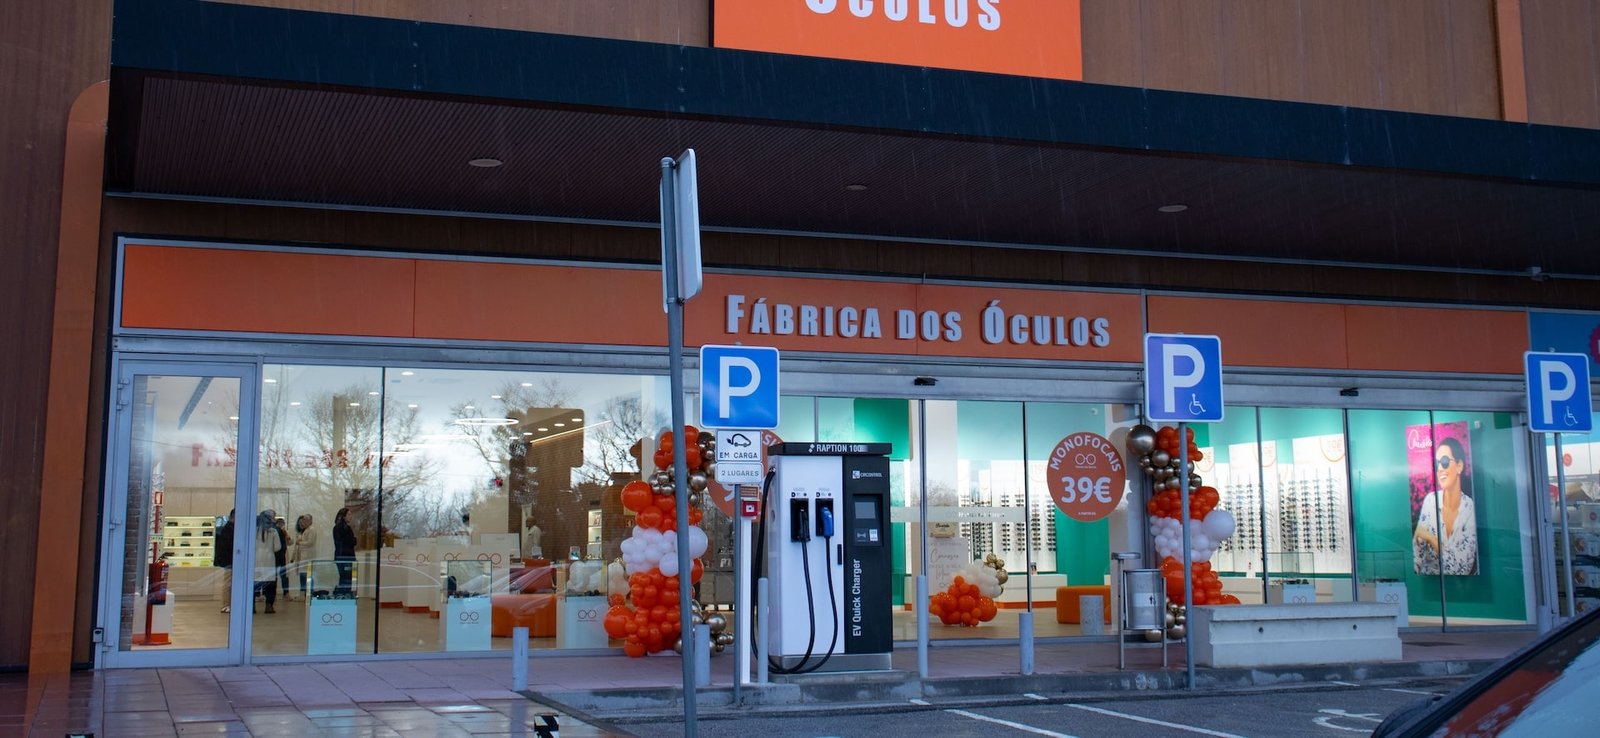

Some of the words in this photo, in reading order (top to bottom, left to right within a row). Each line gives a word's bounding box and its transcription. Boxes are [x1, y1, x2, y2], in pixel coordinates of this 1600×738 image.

[725, 294, 882, 338] FÁBRICA
[896, 309, 962, 341] DOS
[982, 299, 1110, 347] ÓCULOS
[719, 356, 761, 418] P
[1163, 344, 1205, 412] P
[1540, 361, 1576, 424] P
[816, 444, 847, 452] RAPTION
[1050, 435, 1121, 472] MONOFOCAIS
[1061, 476, 1112, 503] 39€
[852, 559, 862, 595] Charger
[852, 597, 862, 623] Quick
[852, 625, 862, 636] EV
